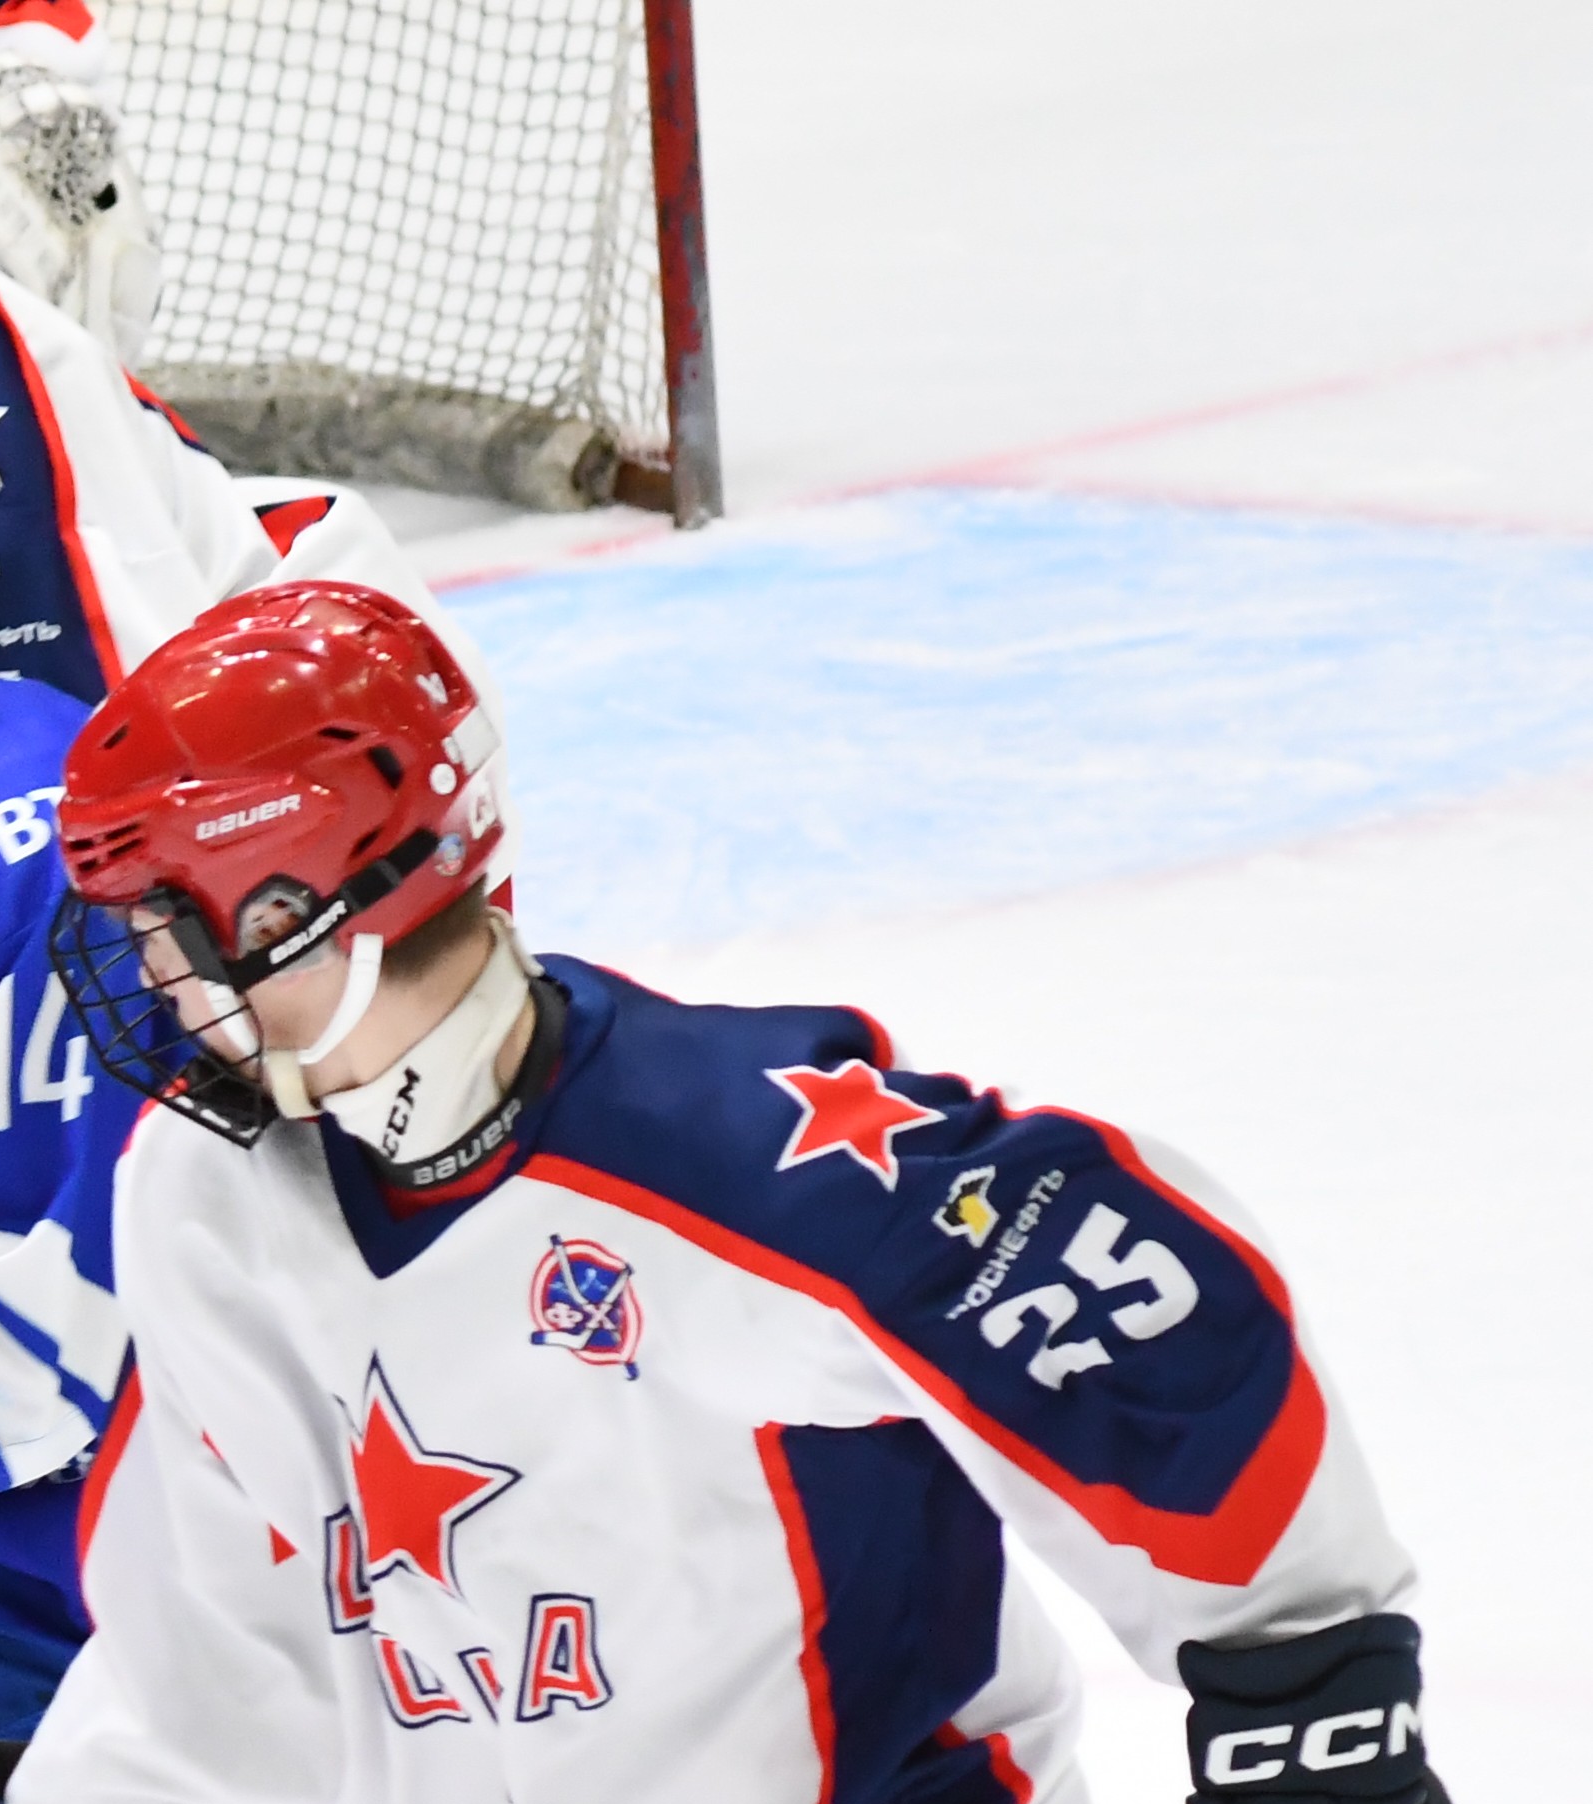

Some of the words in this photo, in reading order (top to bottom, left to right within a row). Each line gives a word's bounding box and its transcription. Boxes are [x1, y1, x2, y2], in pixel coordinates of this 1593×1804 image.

[195, 794, 302, 841] BAUER
[269, 899, 348, 966] BAUER
[383, 1065, 422, 1163] CCM
[979, 1202, 1201, 1391] 25
